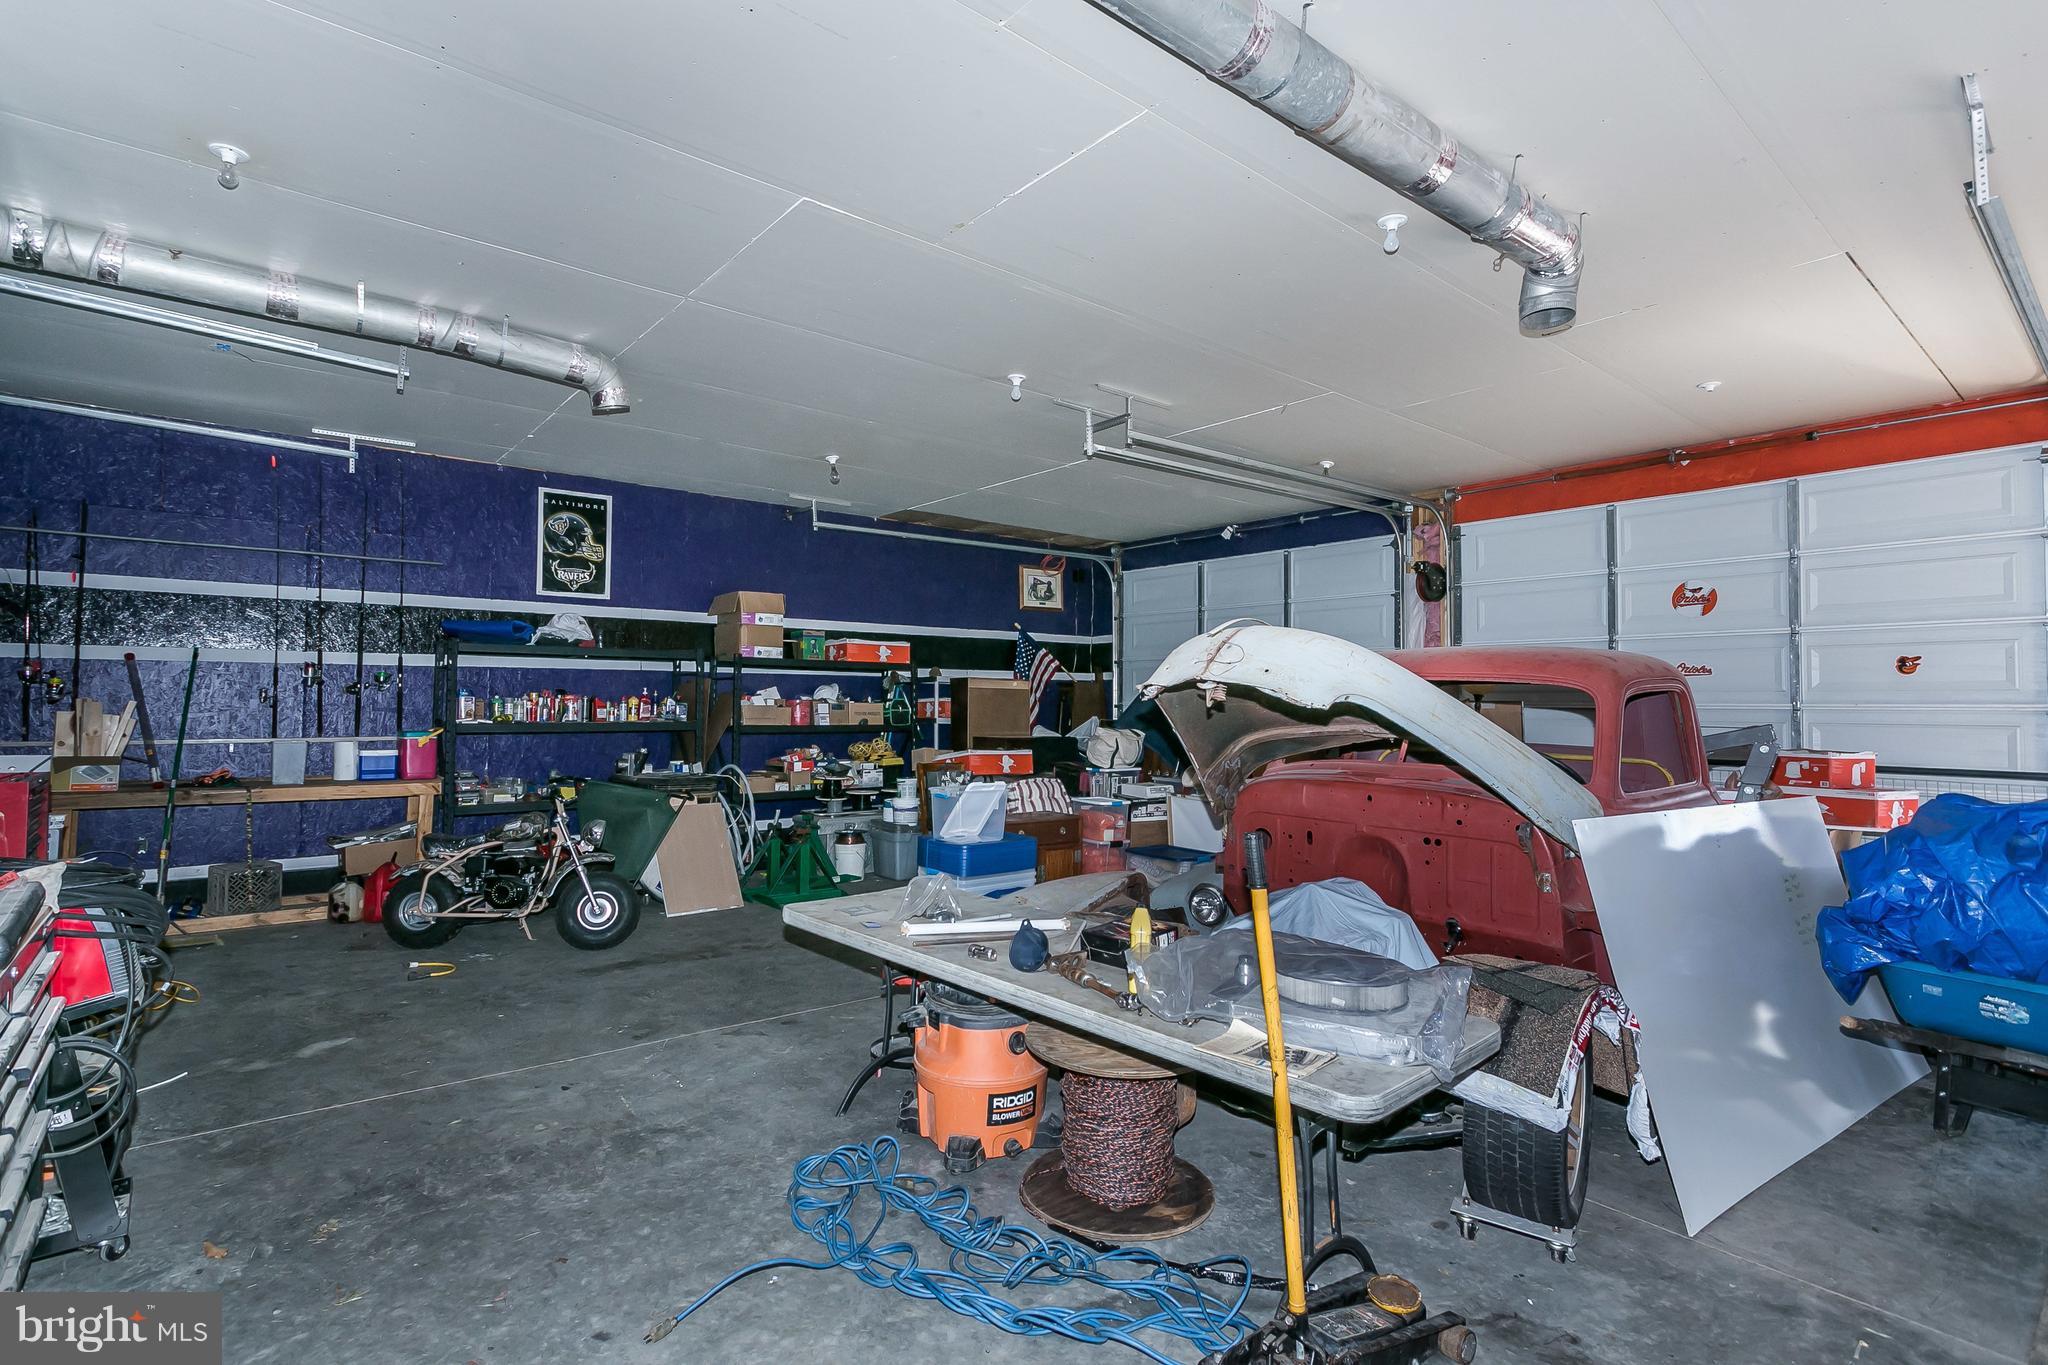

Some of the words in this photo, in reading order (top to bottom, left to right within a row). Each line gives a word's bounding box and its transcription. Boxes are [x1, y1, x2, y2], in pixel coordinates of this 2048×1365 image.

[543, 498, 605, 511] BALTIMORE
[557, 570, 590, 581] RAVENS
[993, 1091, 1034, 1108] RIDGID
[992, 1110, 1020, 1120] BLOWER
